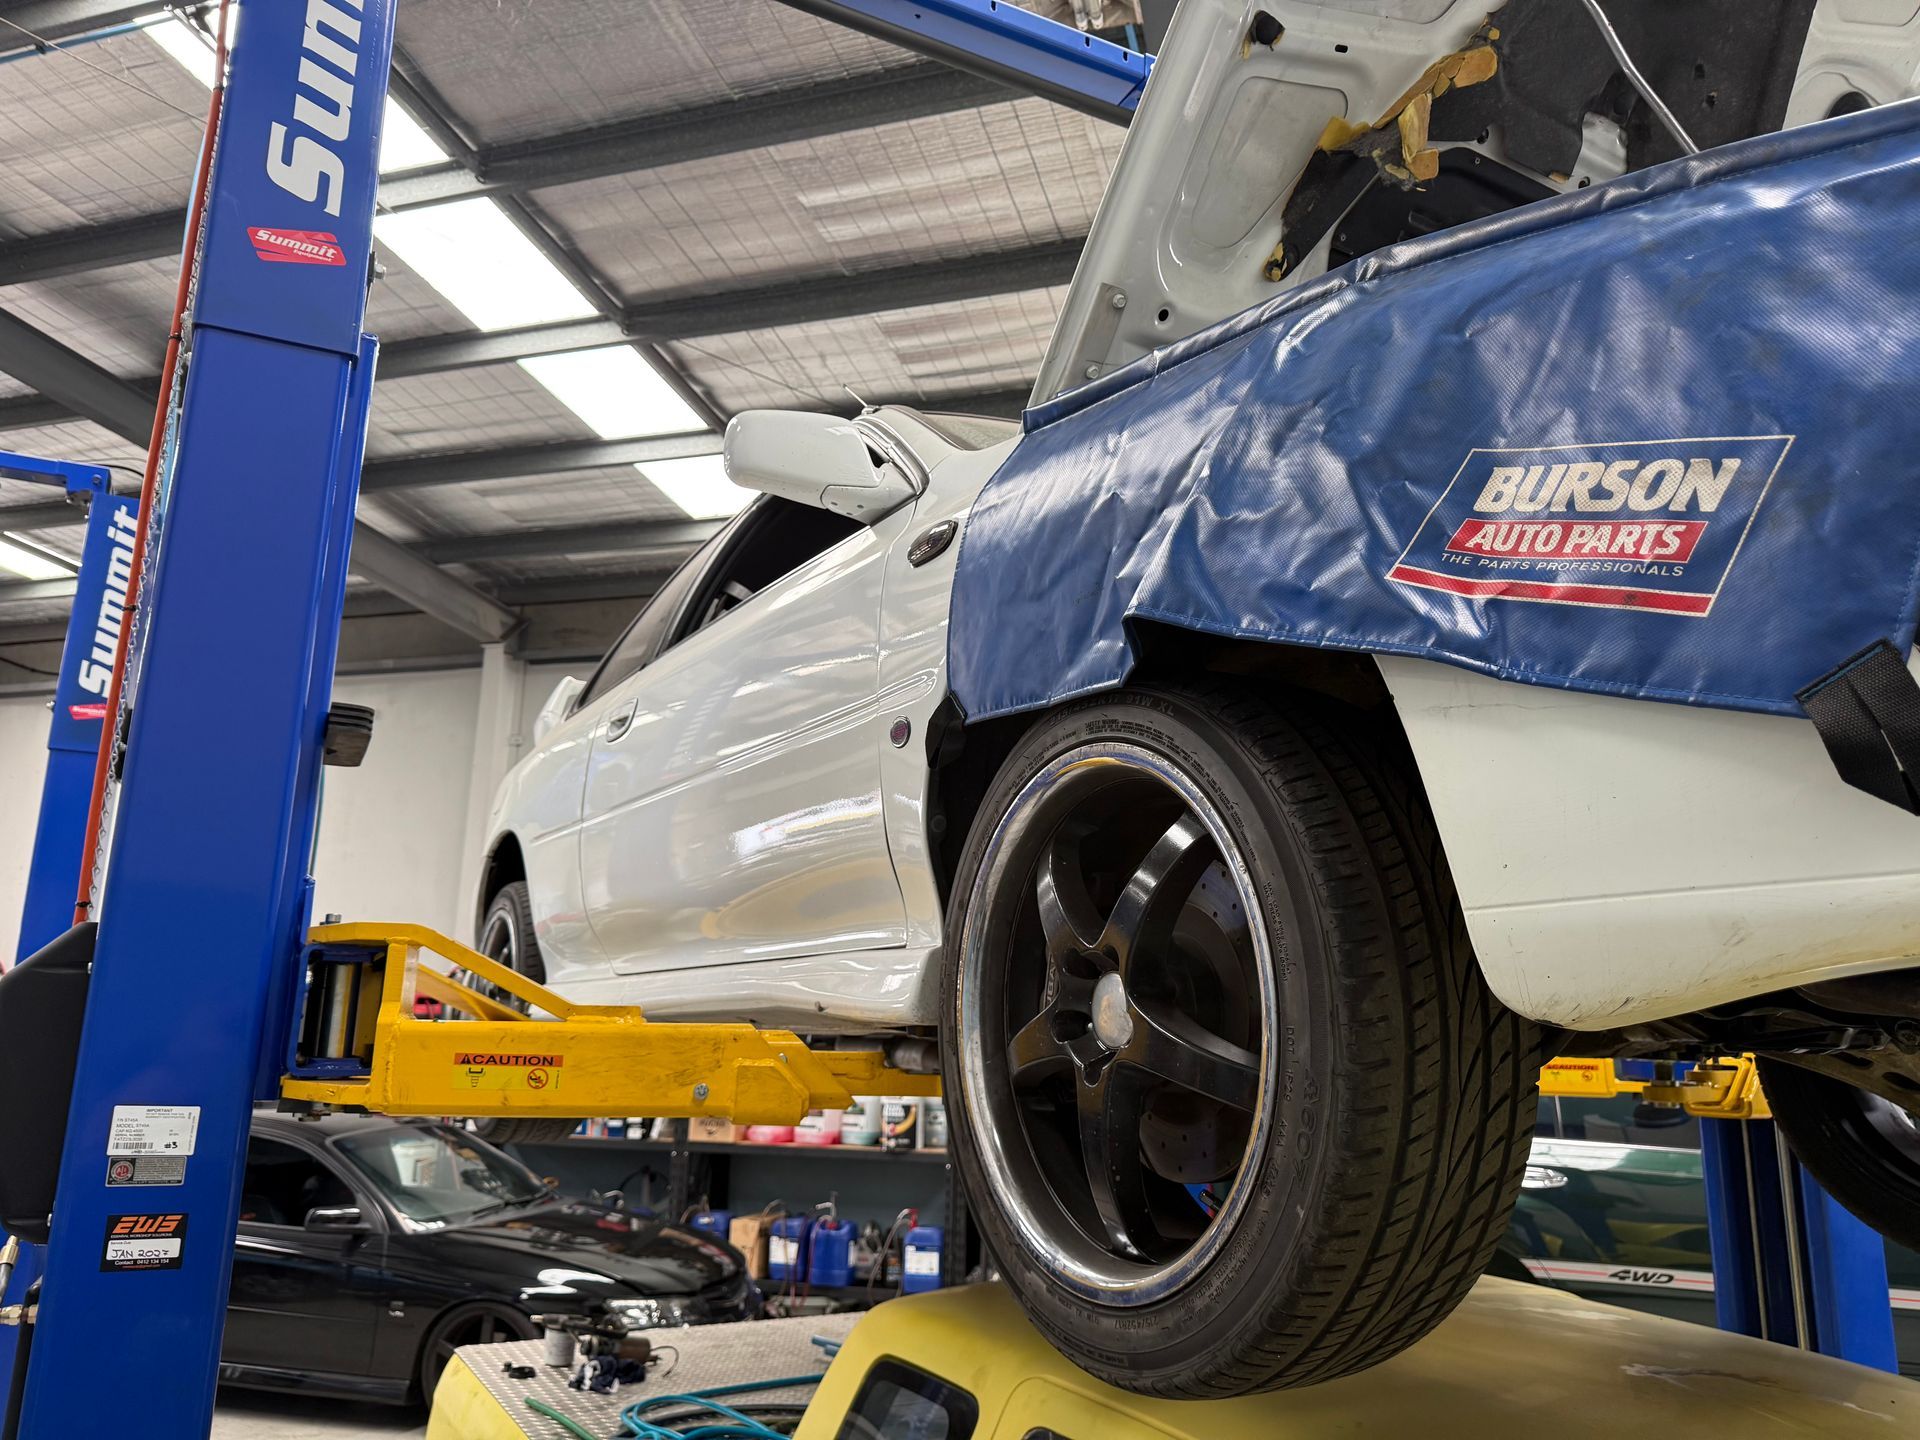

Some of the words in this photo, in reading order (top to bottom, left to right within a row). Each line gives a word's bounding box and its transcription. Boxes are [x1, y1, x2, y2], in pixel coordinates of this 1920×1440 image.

[255, 228, 337, 259] Summit
[293, 249, 332, 262] Equipment
[1473, 458, 1742, 513] BURSON
[1465, 523, 1557, 553] AUTO
[1562, 520, 1687, 556] PARTS
[1440, 551, 1474, 565] THE
[1479, 556, 1531, 571] PARTS
[1534, 560, 1685, 578] PROFESSIONALS
[78, 504, 138, 699] Summit
[473, 1054, 554, 1066] CAUTION
[1552, 1063, 1595, 1071] CAUTION
[164, 1141, 178, 1149] #3
[112, 1215, 183, 1234] EWS
[111, 1249, 134, 1258] JAN
[1608, 1269, 1674, 1284] 4WD
